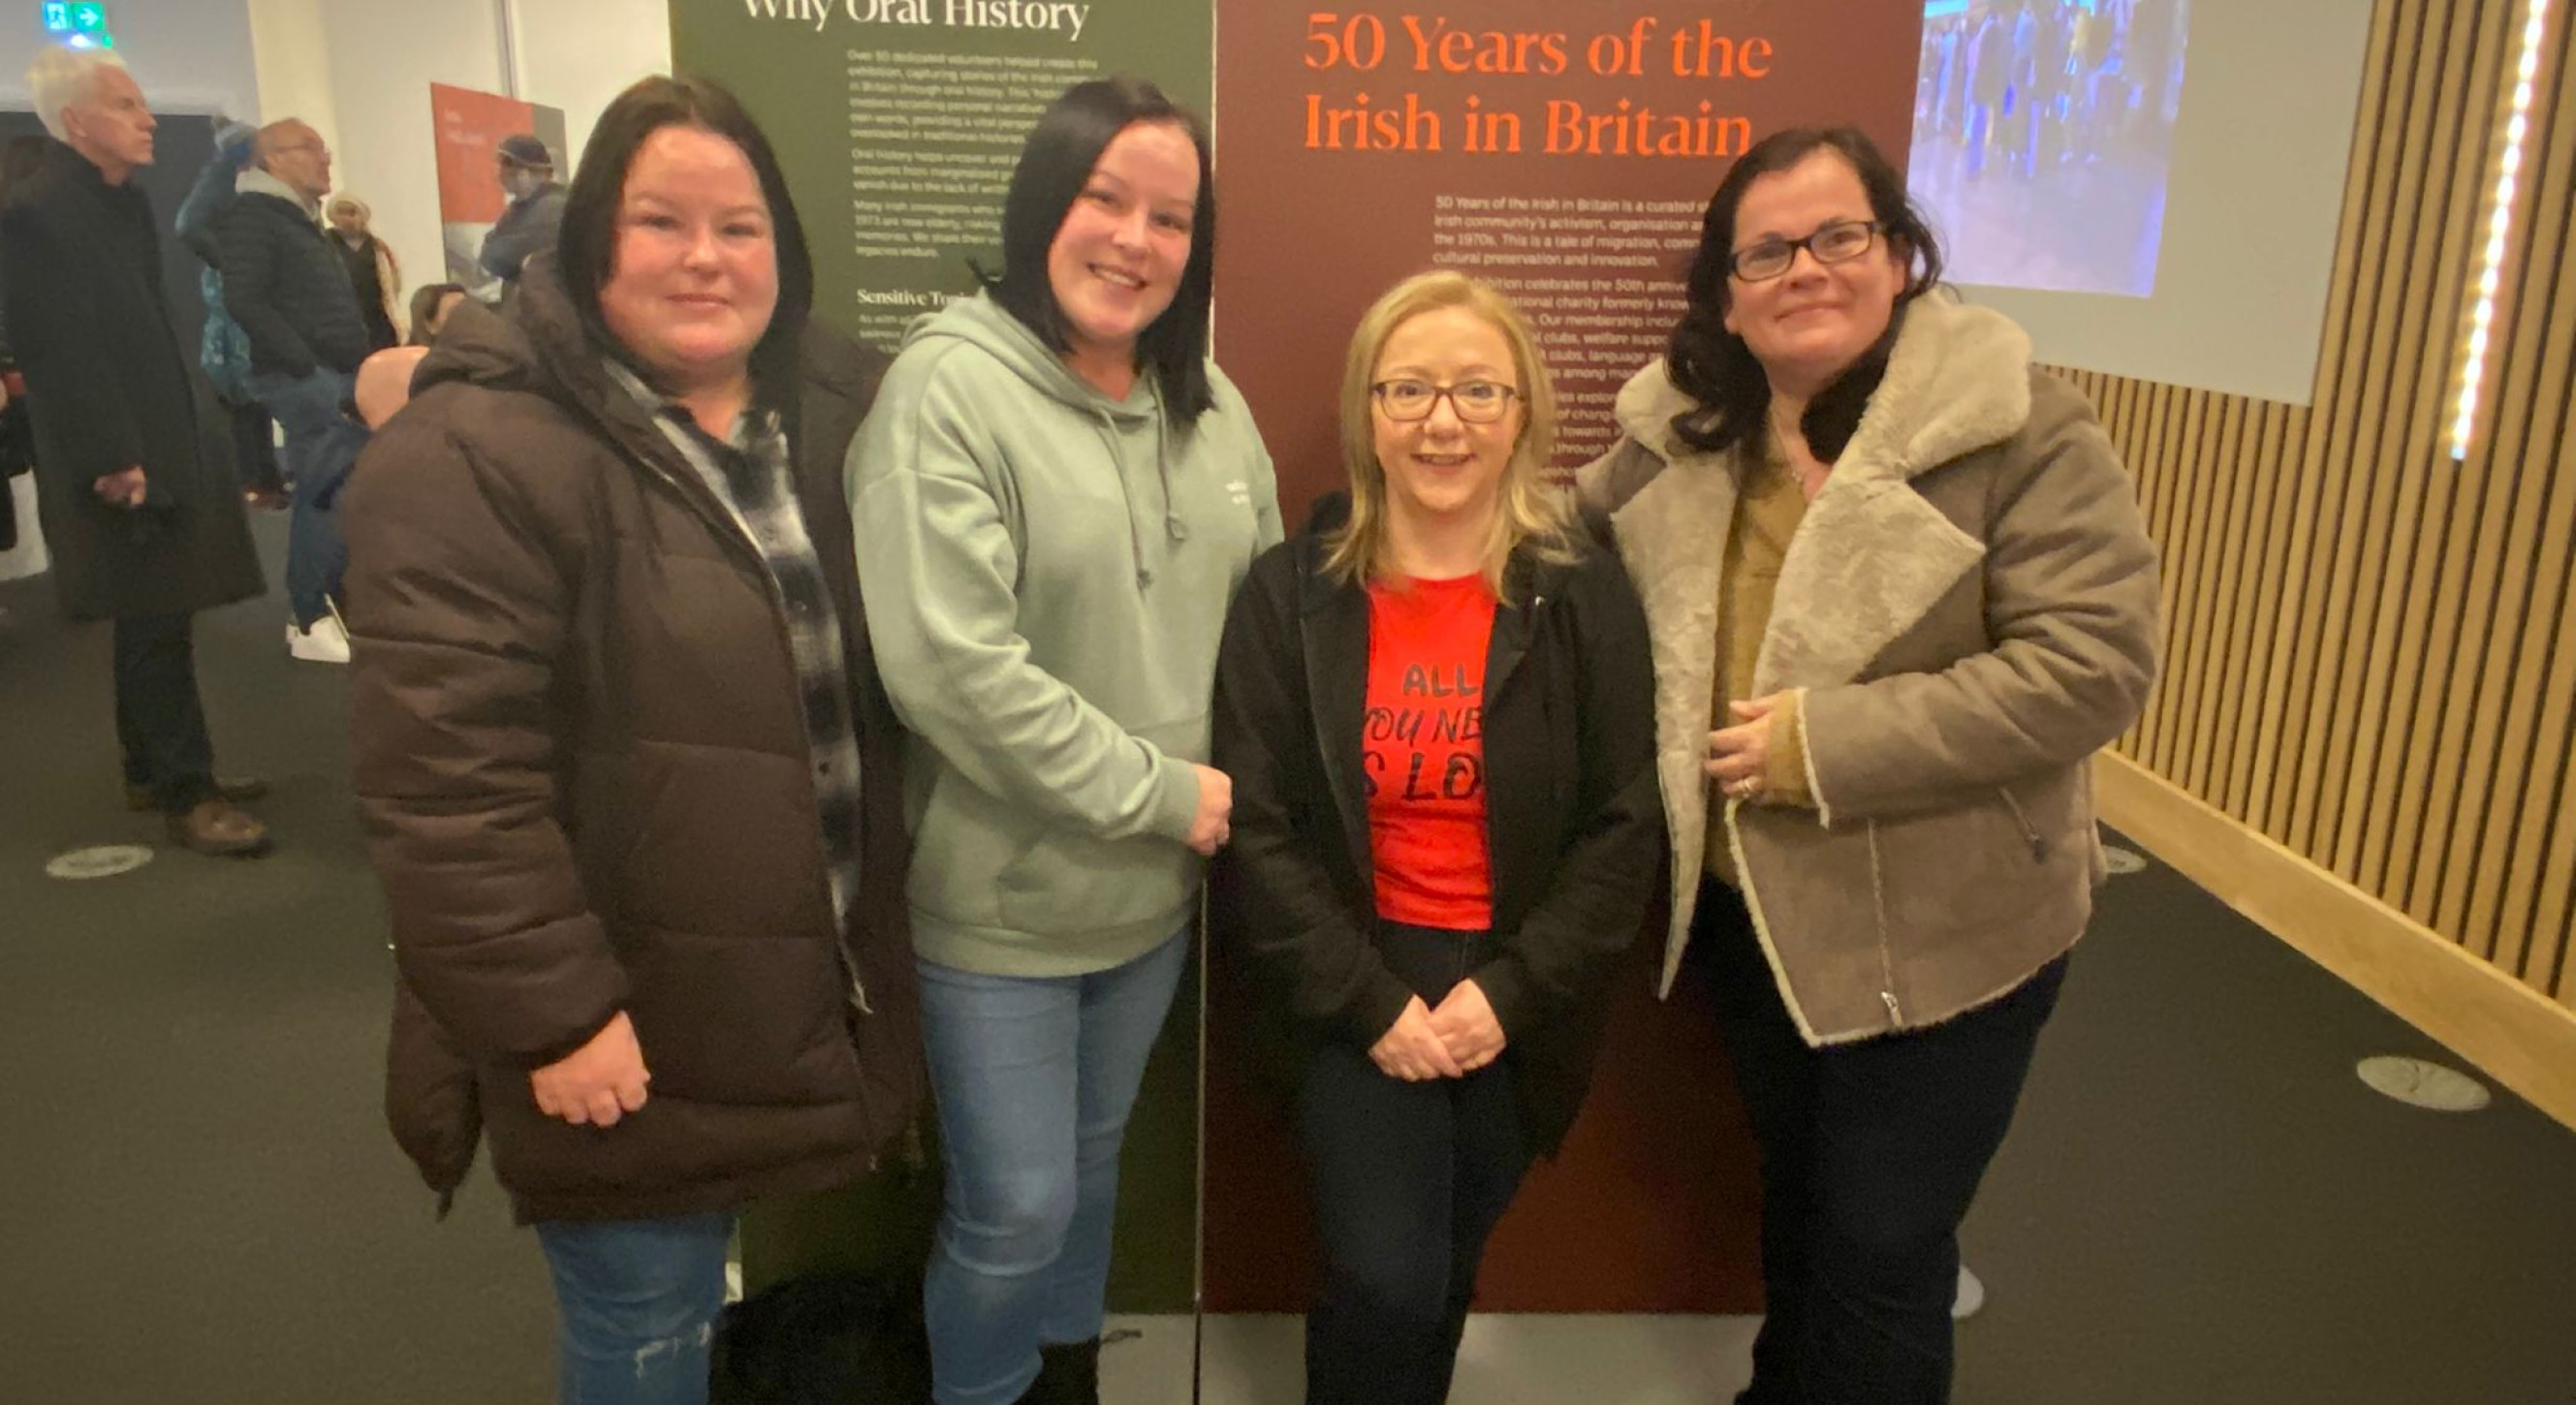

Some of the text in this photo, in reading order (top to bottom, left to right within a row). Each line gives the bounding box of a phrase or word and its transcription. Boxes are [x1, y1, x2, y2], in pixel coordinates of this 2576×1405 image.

[846, 0, 932, 25] Oral
[944, 0, 1090, 42] History
[1305, 12, 1773, 78] 50 Years of the
[1305, 92, 1751, 156] Irish in Britain
[1435, 195, 1454, 209] 50
[1455, 196, 1491, 210] Years
[1492, 196, 1506, 210] of
[1507, 197, 1530, 210] the
[1531, 197, 1559, 211] Irish
[1561, 199, 1575, 210] in
[1576, 198, 1619, 212] Britain
[1620, 200, 1633, 212] is
[1635, 201, 1645, 212] a
[1646, 200, 1695, 213] curated
[1434, 214, 1462, 228] Irish
[1464, 215, 1548, 231] community's
[1549, 215, 1607, 231] activism,
[1609, 217, 1689, 233] organisation
[1434, 232, 1455, 245] the
[1501, 233, 1528, 247] This
[1529, 234, 1541, 247] is
[1543, 236, 1553, 247] a
[1554, 234, 1579, 248] tale
[1580, 234, 1594, 248] of
[1595, 235, 1661, 251] migration,
[1432, 251, 1659, 267] cultural preservation and innovation.
[1524, 278, 1589, 292] celebrates
[1591, 279, 1613, 293] the
[1615, 279, 1646, 294] 50th
[857, 289, 927, 306] Sensitive
[1555, 297, 1599, 312] charity
[1602, 297, 1653, 312] formerly
[1539, 314, 1563, 328] Our
[1565, 314, 1644, 328] membership
[1587, 349, 1646, 365] language
[1562, 368, 1606, 382] among
[1402, 664, 1480, 698] ALL
[1431, 706, 1482, 744] NE
[1401, 751, 1481, 801] LO
